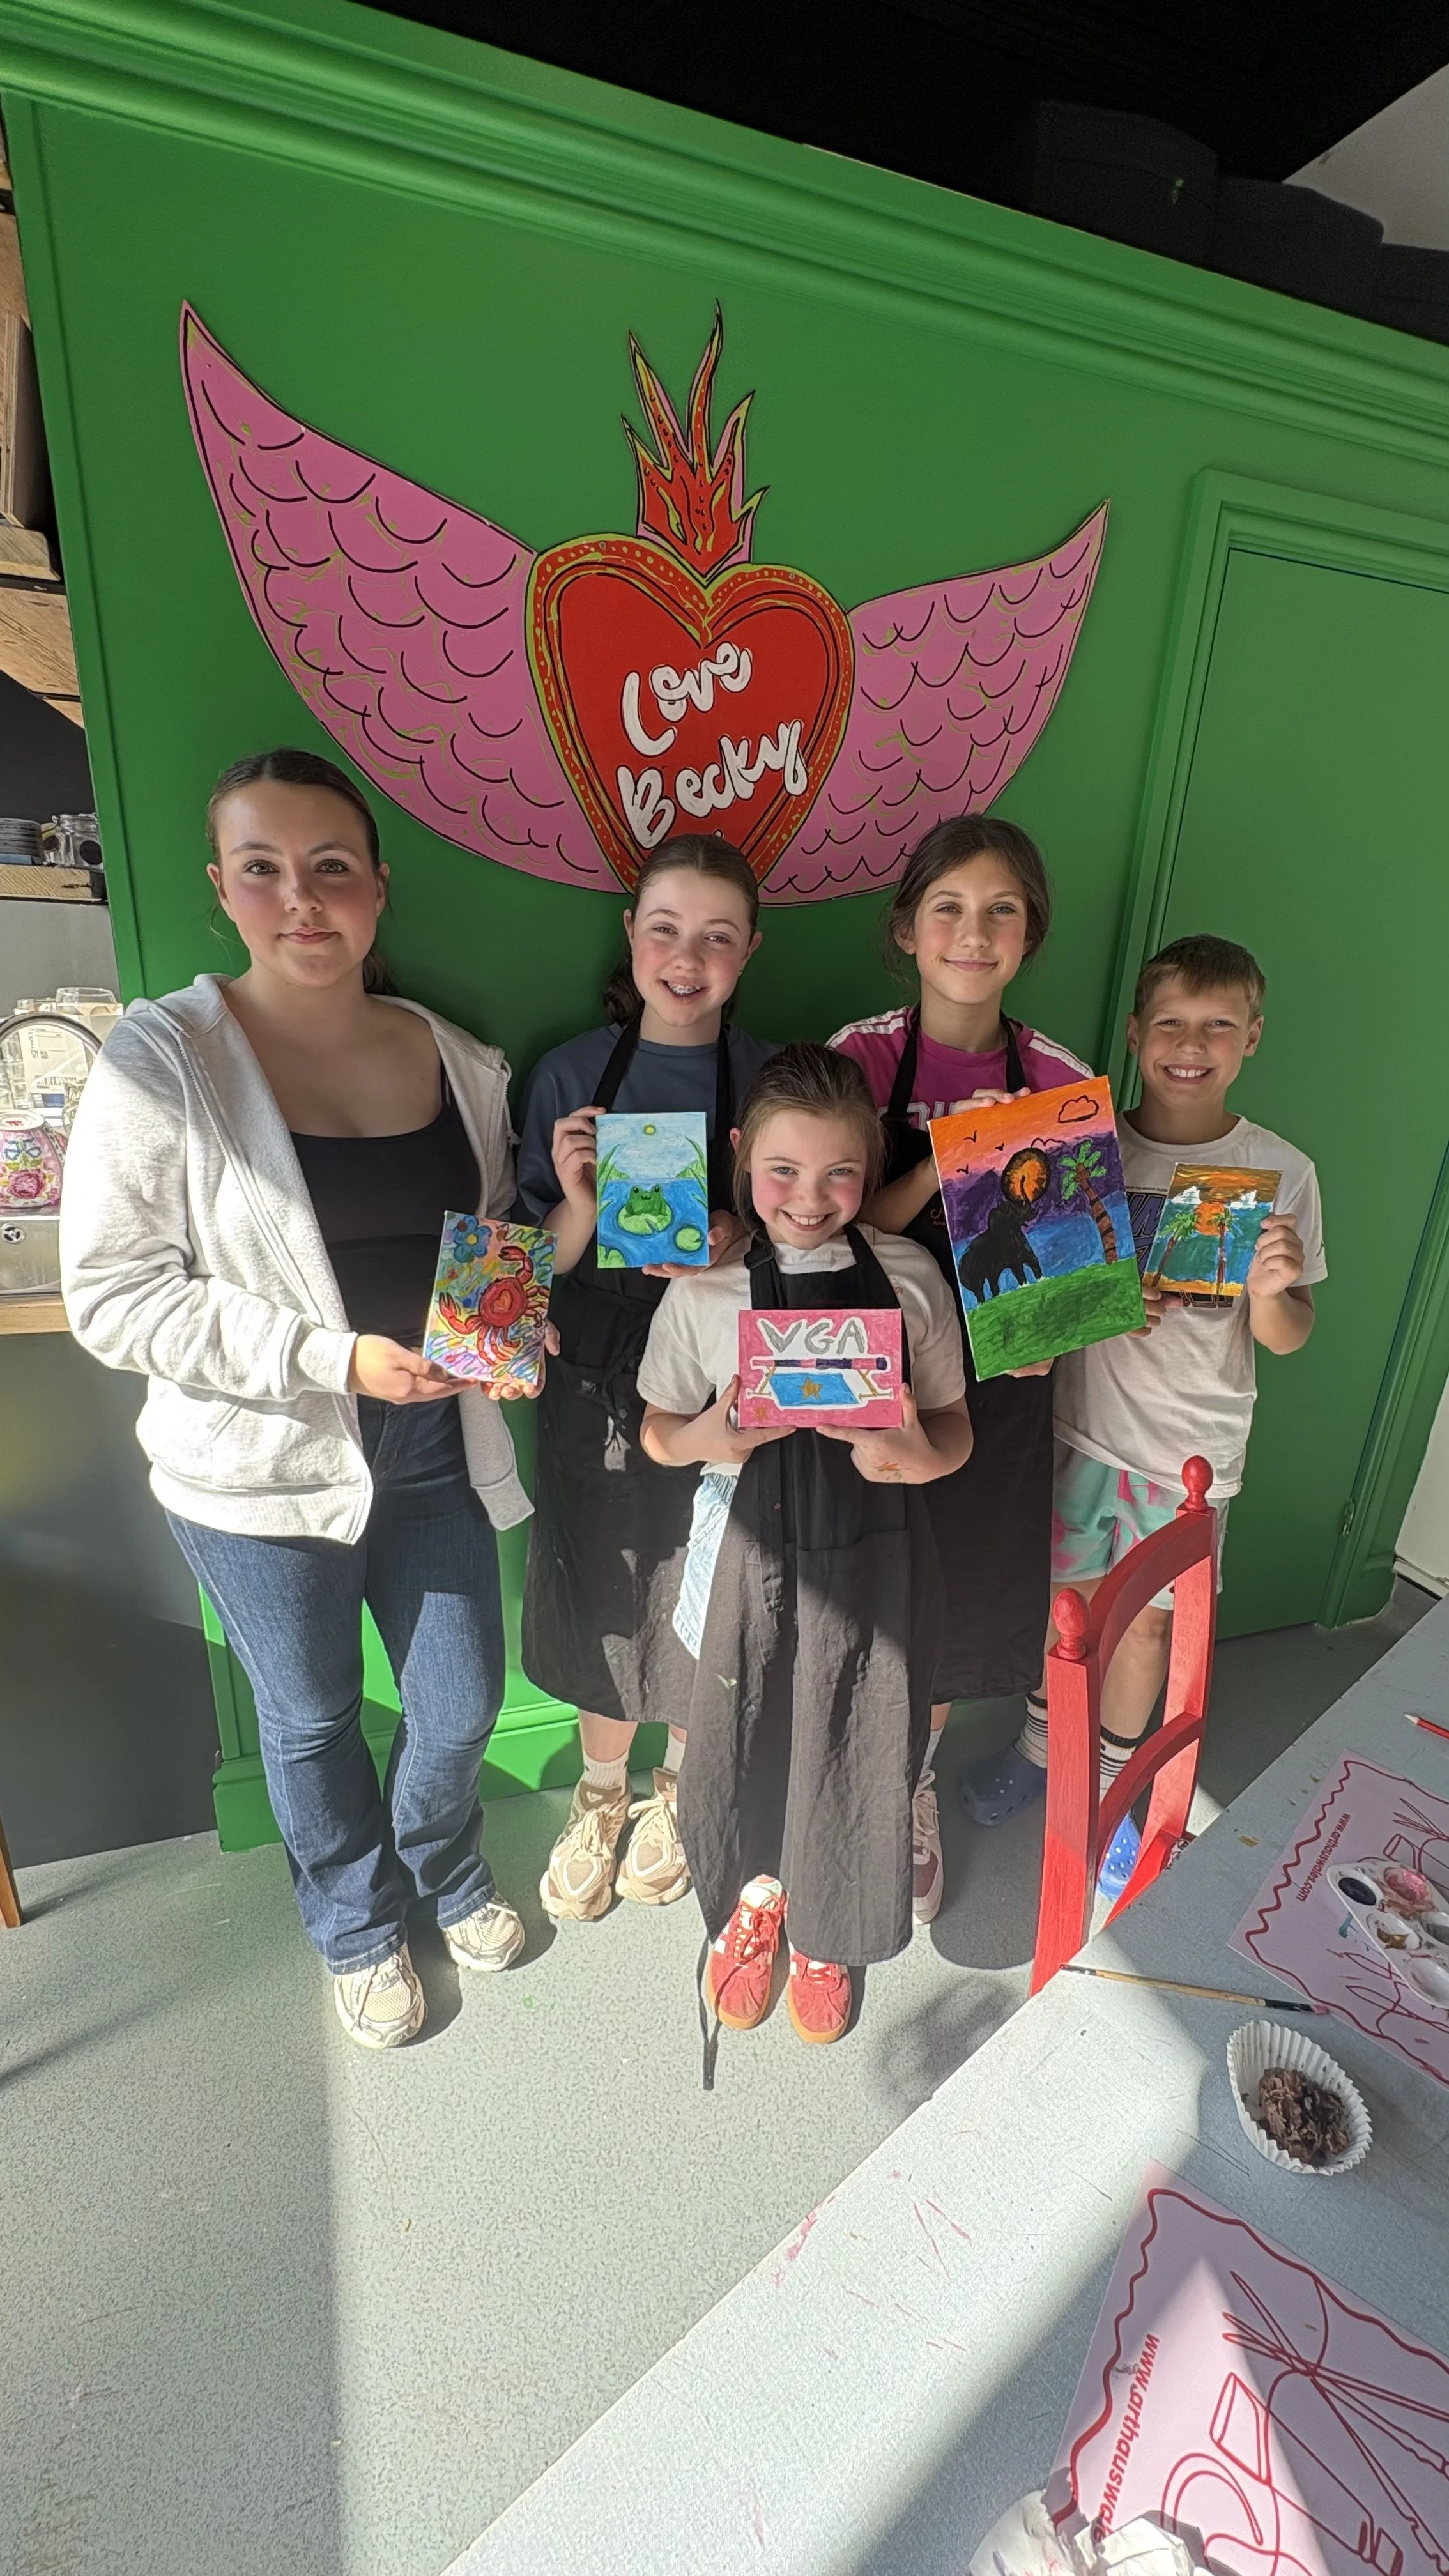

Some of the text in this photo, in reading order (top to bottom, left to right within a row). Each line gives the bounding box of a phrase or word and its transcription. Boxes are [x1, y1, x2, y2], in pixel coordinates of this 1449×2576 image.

[621, 640, 753, 756] Love
[617, 719, 809, 850] Becky
[759, 1319, 867, 1355] VGA
[1296, 1812, 1352, 1902] www.arthauswales.com
